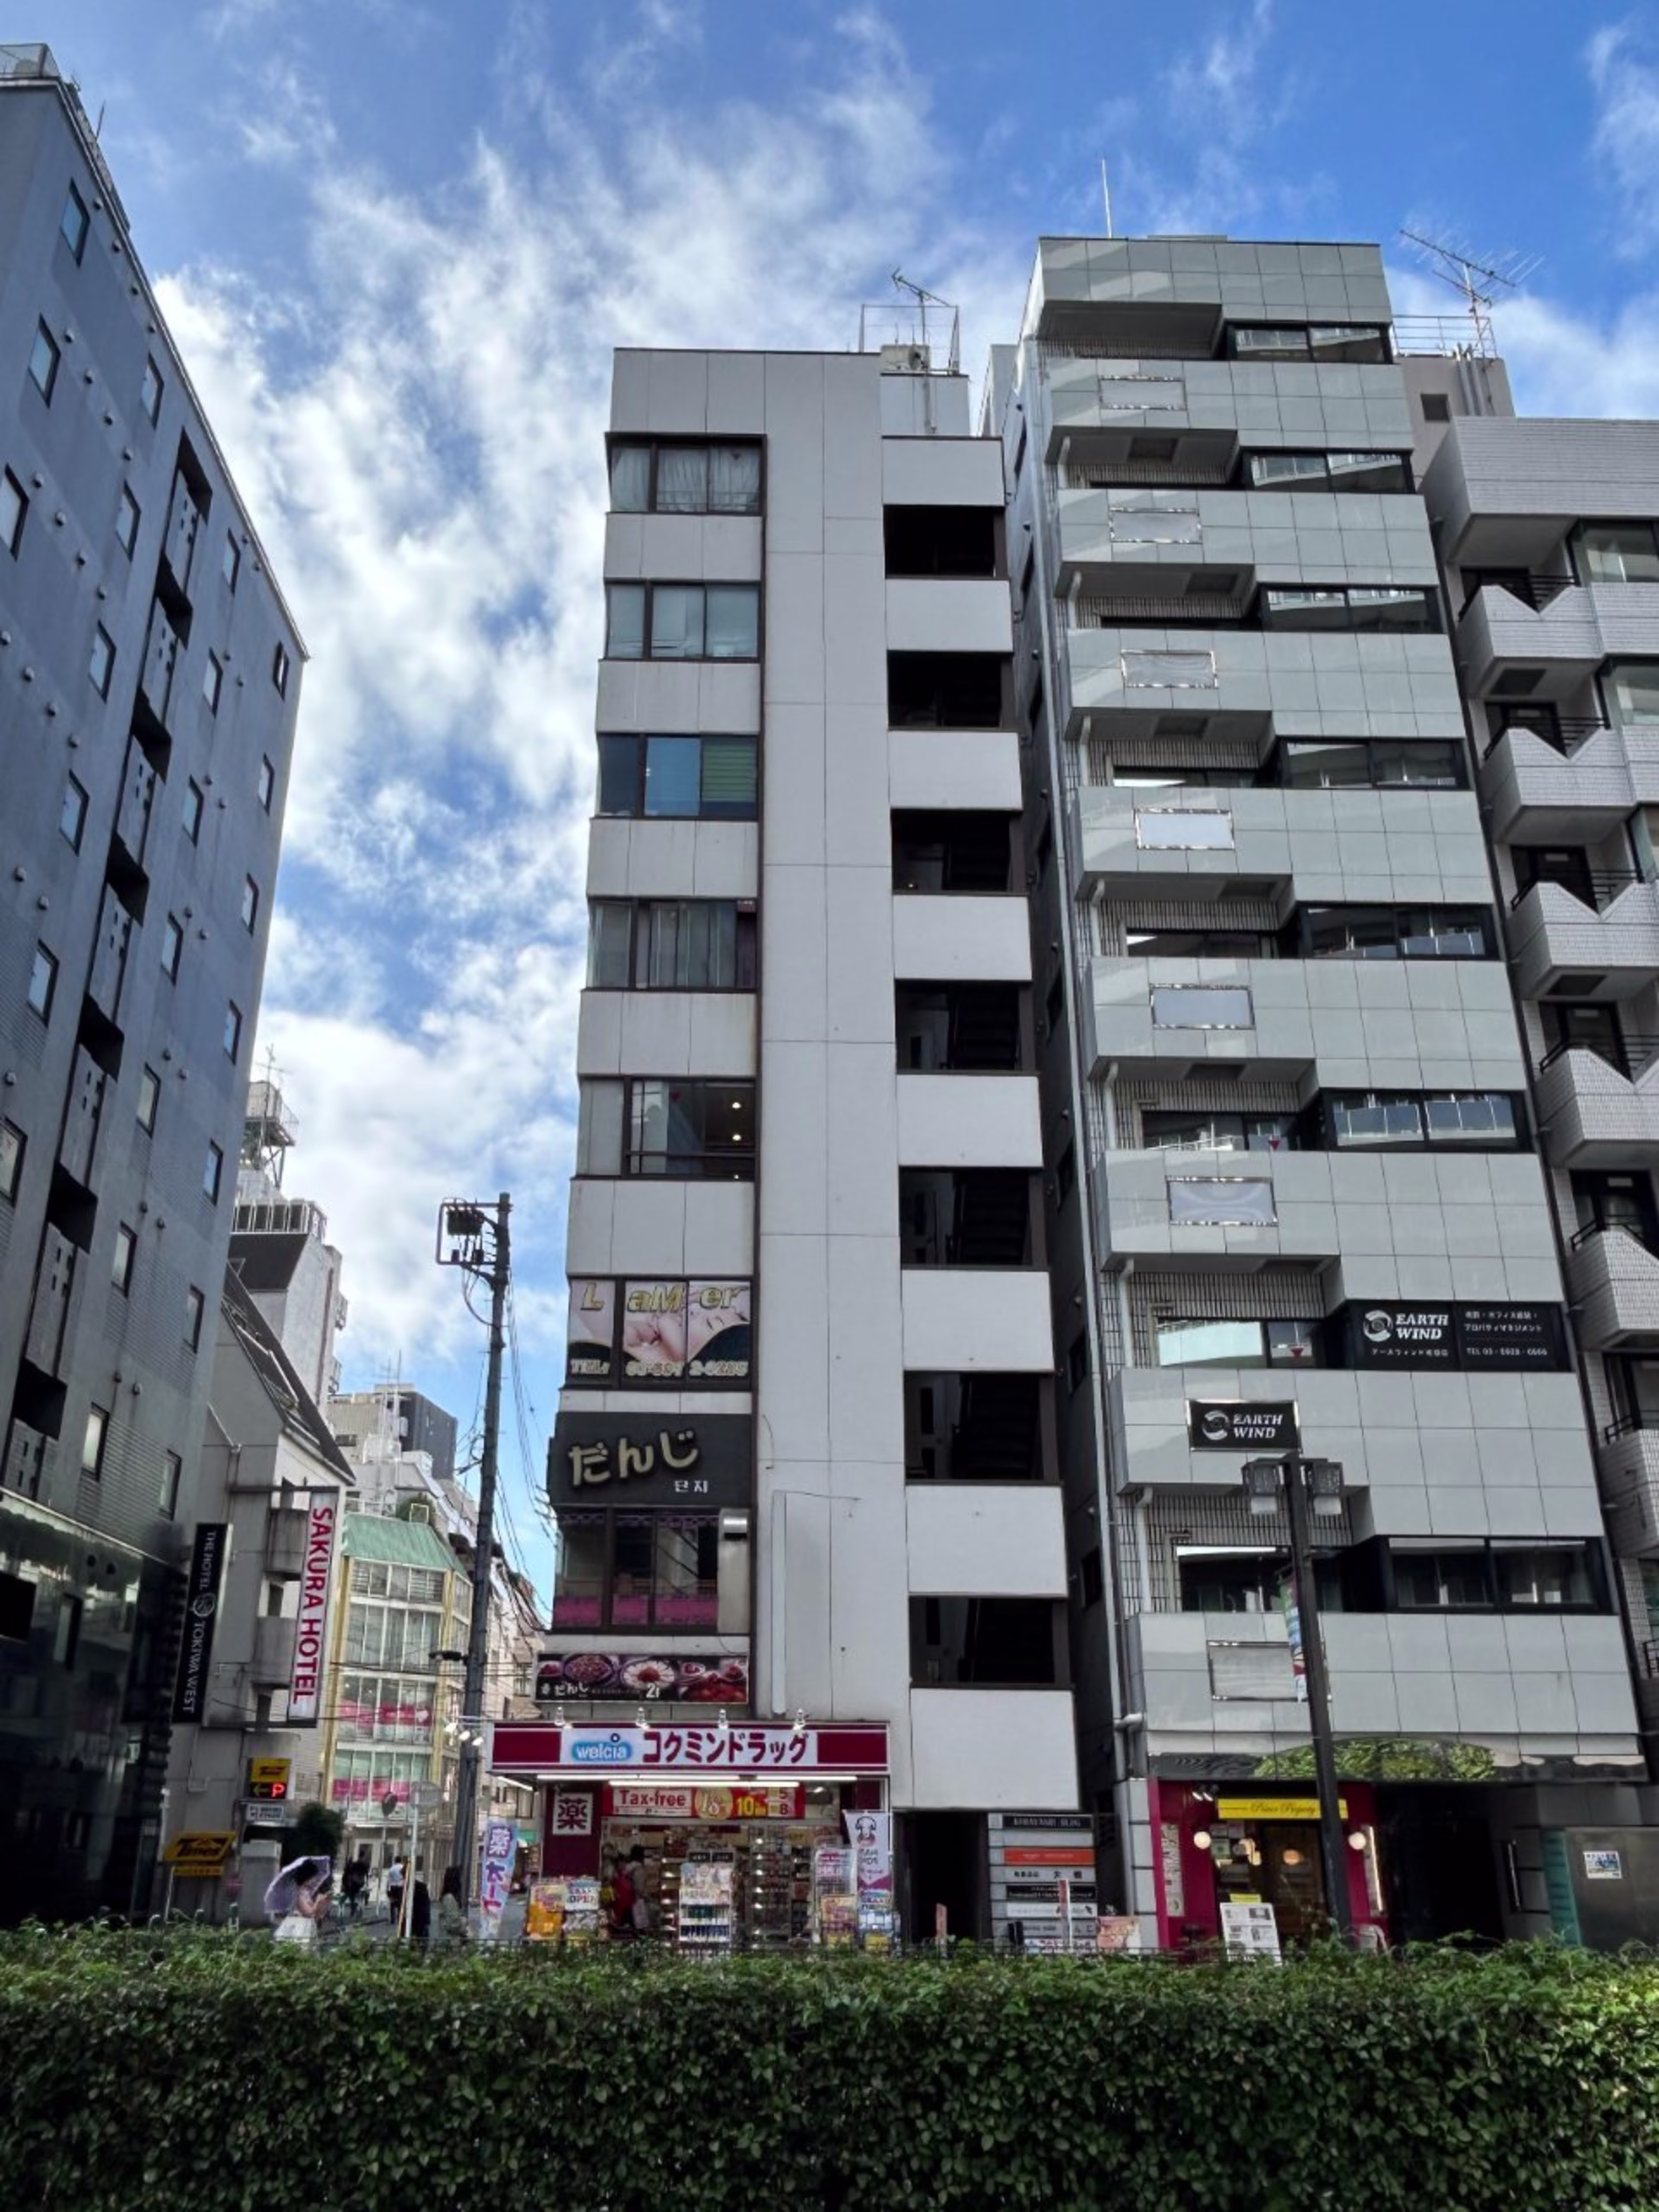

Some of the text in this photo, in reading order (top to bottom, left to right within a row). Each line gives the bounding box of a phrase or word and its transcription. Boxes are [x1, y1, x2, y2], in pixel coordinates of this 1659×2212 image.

[1396, 1313, 1449, 1326] EARTH
[1396, 1328, 1442, 1340] WIND
[1233, 1414, 1283, 1425] EARTH
[1233, 1427, 1276, 1439] WIND
[568, 1430, 699, 1486] だんじ
[200, 1532, 216, 1590] THE HOTEL
[293, 1507, 333, 1704] SAKURA HOTEL
[182, 1620, 206, 1713] TOKIWA WEST
[577, 1732, 629, 1761] welcia
[642, 1731, 809, 1764] コクミンドラッグ
[271, 1783, 285, 1797] P
[557, 1798, 587, 1830] 薬
[488, 1827, 511, 1856] 薬
